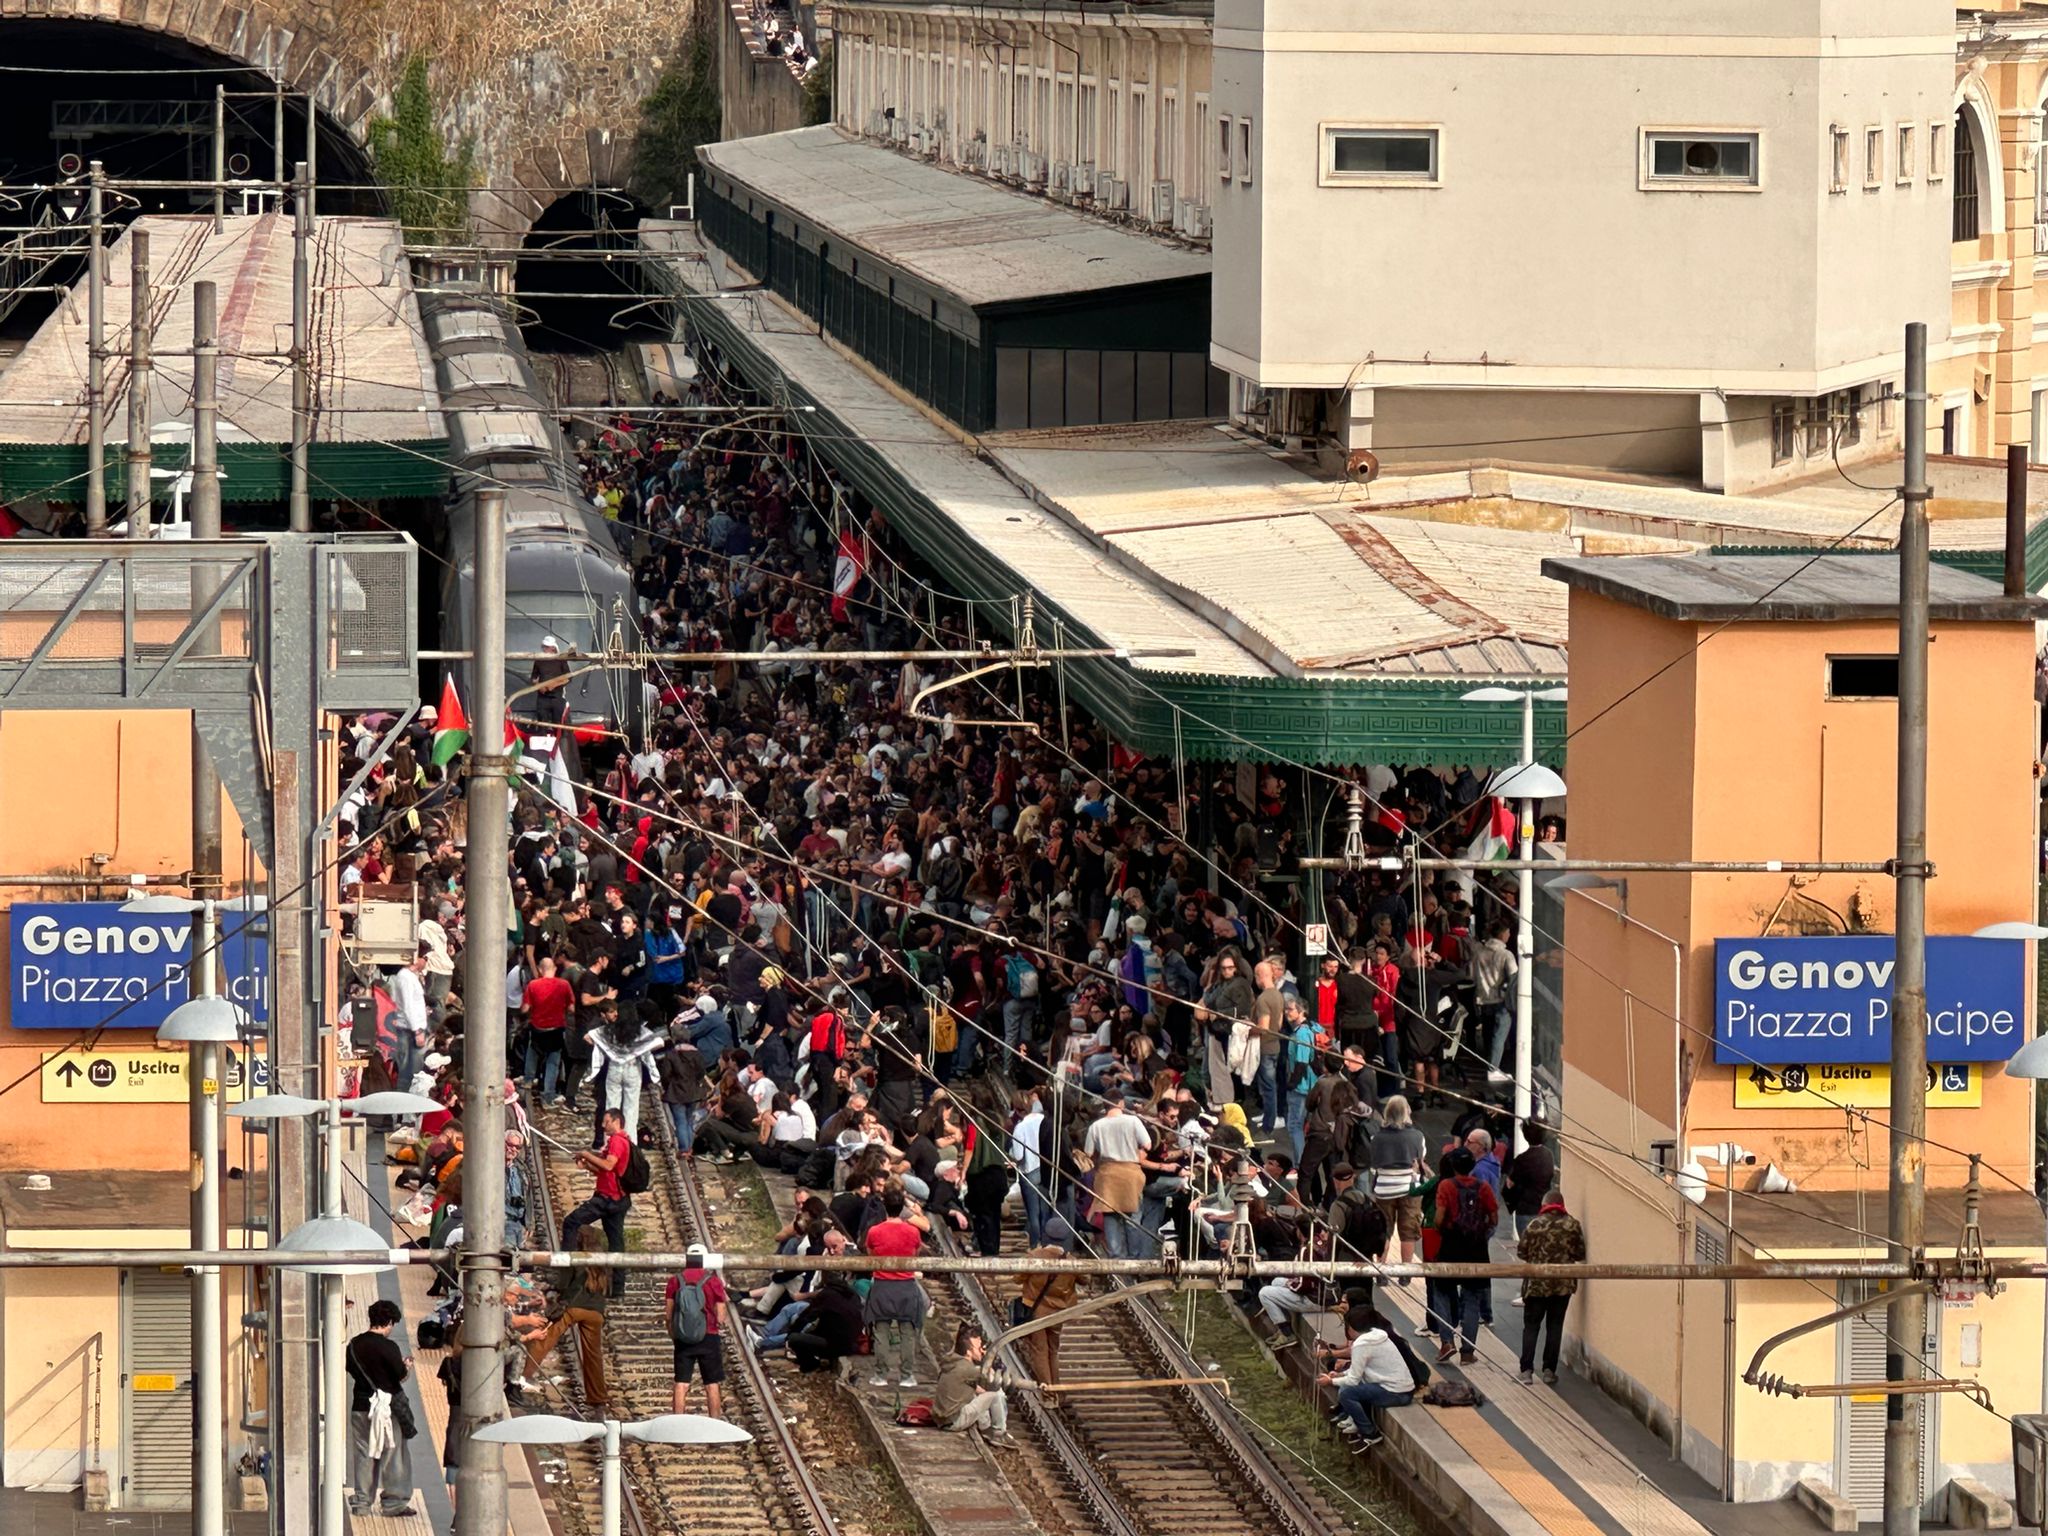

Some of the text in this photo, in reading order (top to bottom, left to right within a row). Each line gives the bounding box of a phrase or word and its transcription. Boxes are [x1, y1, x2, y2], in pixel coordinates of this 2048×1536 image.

[22, 915, 192, 955] Genov
[22, 965, 148, 1003] Piazza
[1728, 950, 1926, 990] Genov
[1728, 998, 2014, 1046] Piazza Pcipe
[128, 1060, 180, 1074] Uscita
[1821, 1065, 1872, 1079] Uscita
